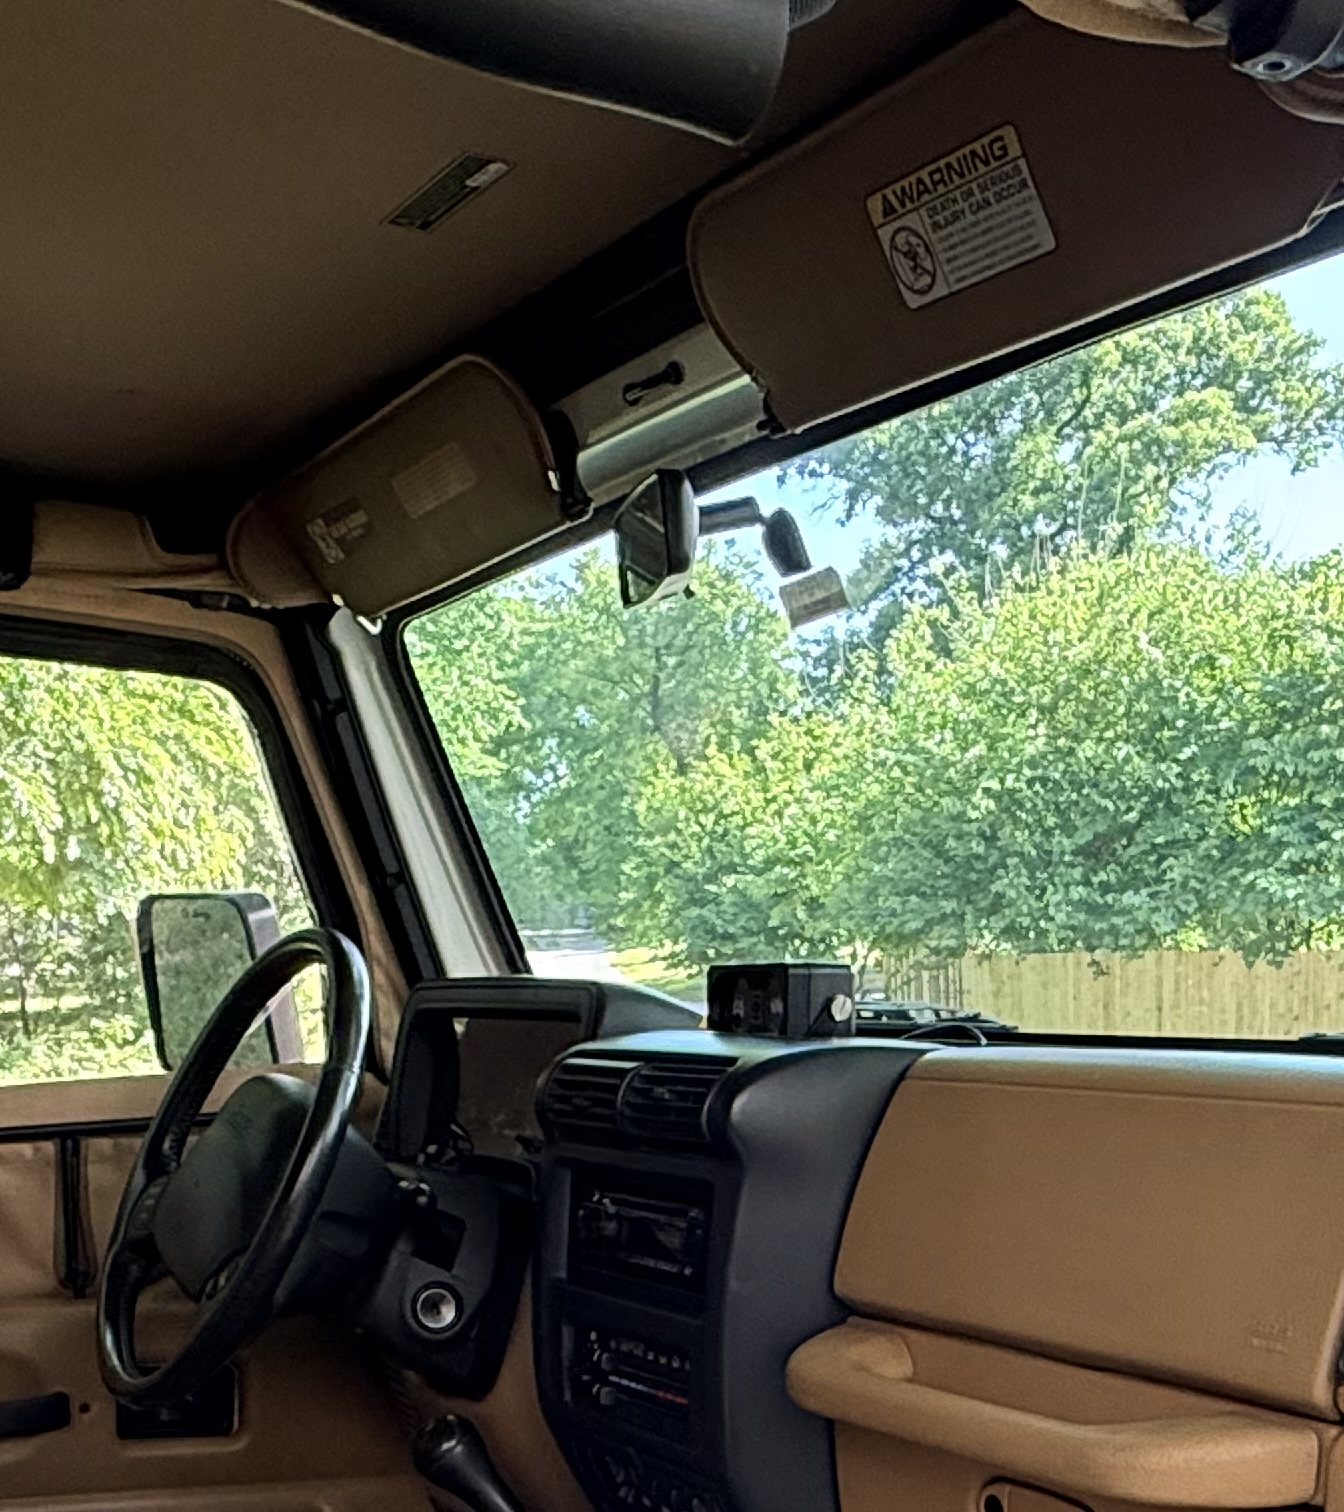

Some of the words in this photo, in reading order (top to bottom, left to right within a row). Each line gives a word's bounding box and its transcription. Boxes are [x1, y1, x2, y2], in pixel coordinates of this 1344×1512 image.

[893, 135, 1010, 210] WARNING
[926, 192, 960, 220] DEATH
[959, 186, 975, 204] OR
[976, 162, 1023, 195] SERIOUS
[930, 208, 968, 233] INJURY
[968, 195, 992, 215] CAN
[992, 177, 1030, 206] OCCUR
